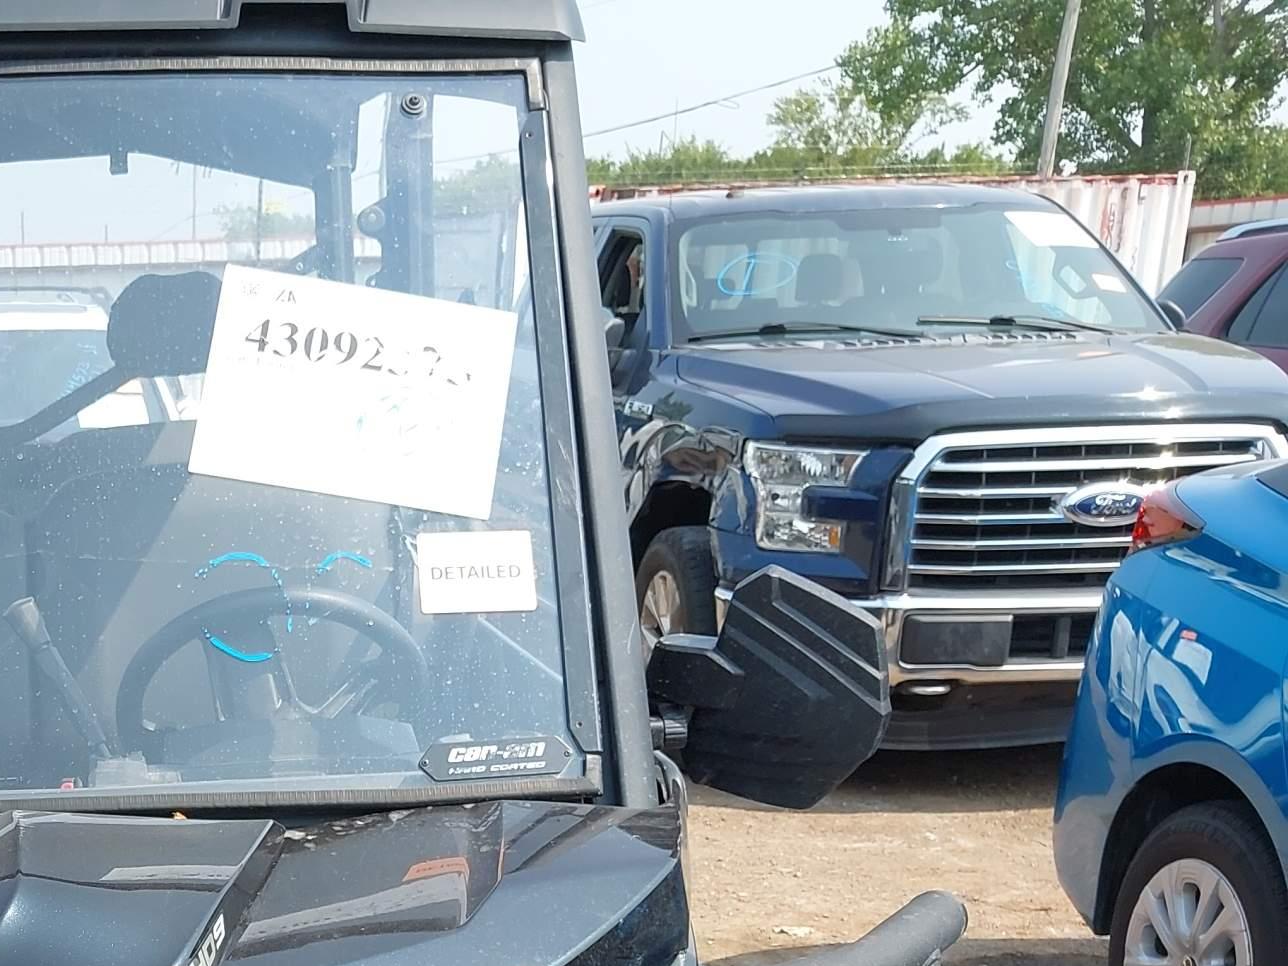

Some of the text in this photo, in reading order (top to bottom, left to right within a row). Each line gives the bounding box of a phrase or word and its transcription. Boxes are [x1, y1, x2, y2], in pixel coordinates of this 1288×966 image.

[1089, 493, 1137, 516] Ford
[431, 564, 521, 581] DETAILED
[490, 761, 546, 772] COATED
